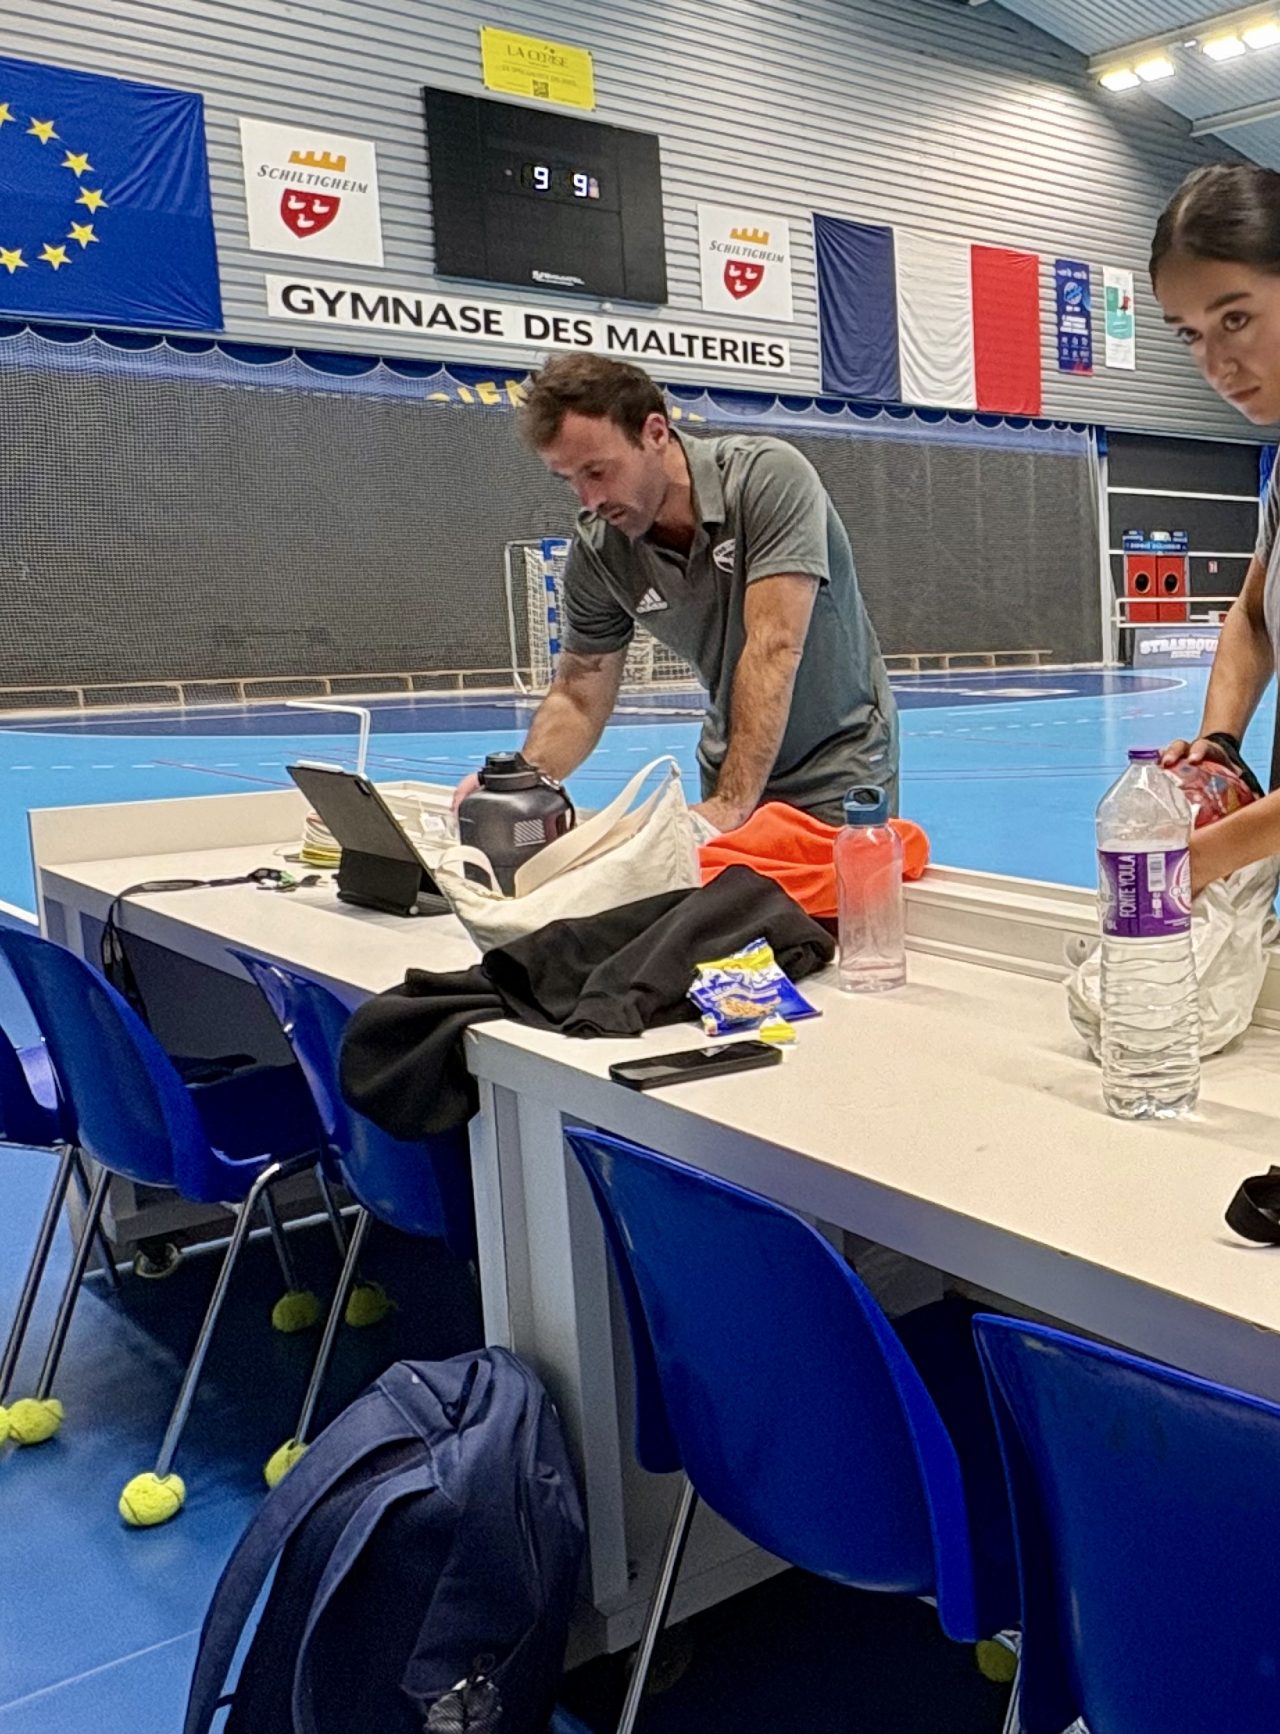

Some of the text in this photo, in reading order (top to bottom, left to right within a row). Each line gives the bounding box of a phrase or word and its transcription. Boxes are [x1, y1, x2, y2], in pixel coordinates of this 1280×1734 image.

[257, 164, 369, 194] SCHILTIGHEIM
[533, 166, 588, 197] 9 9
[708, 240, 785, 264] SCHILTIGHEIM
[281, 284, 785, 368] GYMNASE DES MALTERIES
[1118, 887, 1137, 918] FONTE
